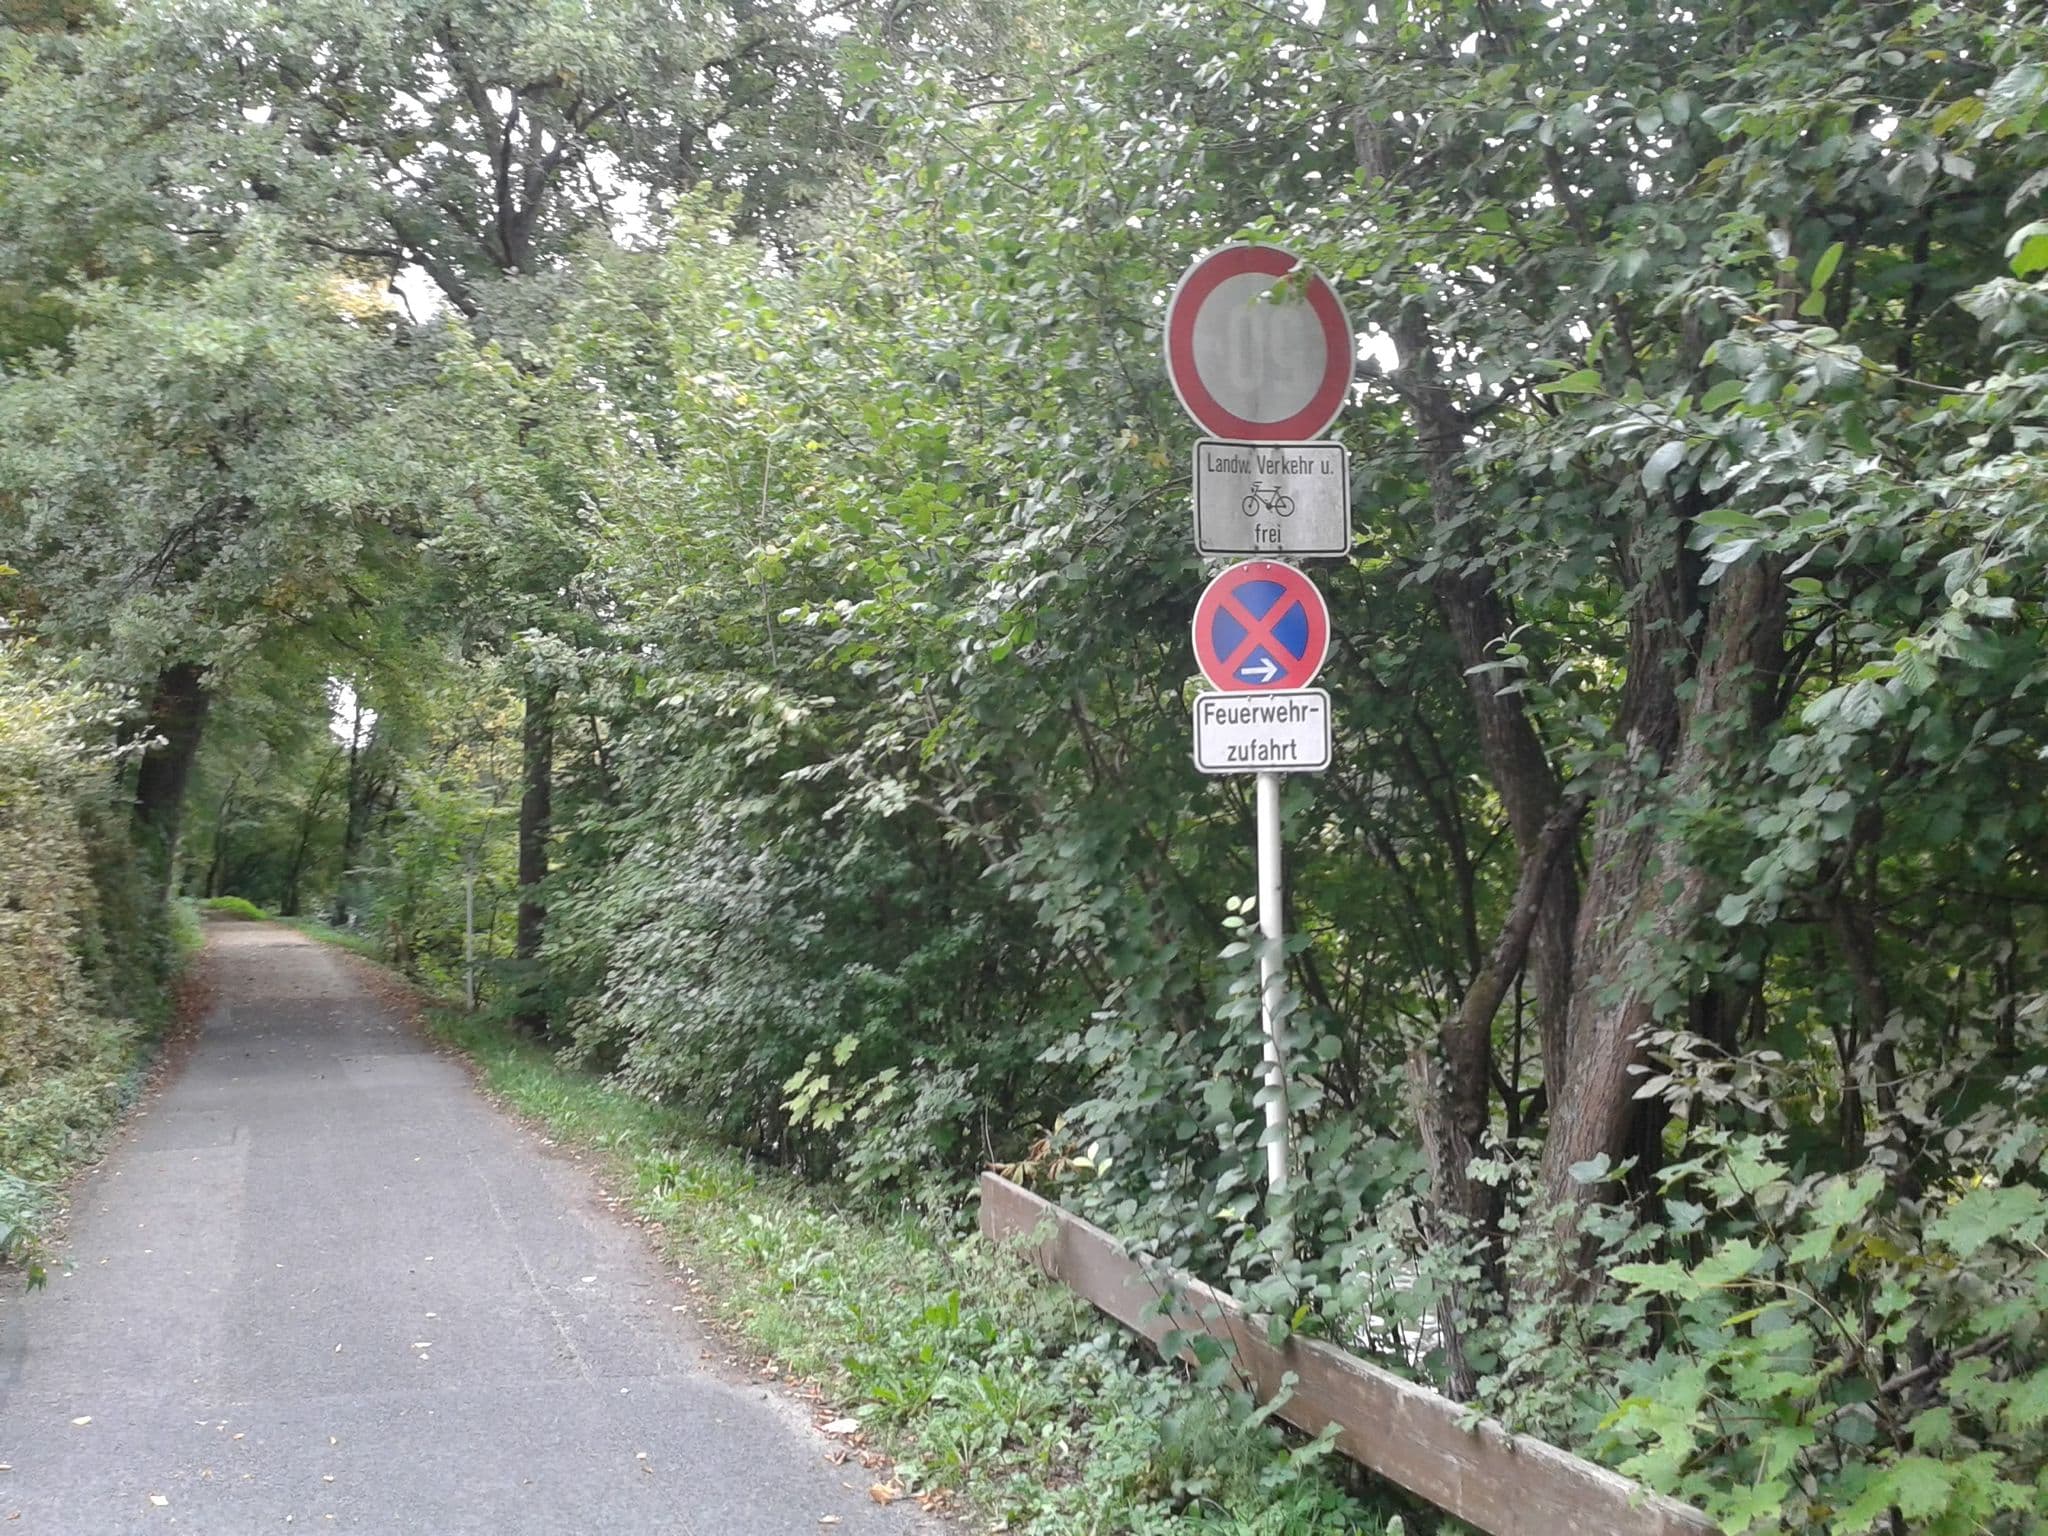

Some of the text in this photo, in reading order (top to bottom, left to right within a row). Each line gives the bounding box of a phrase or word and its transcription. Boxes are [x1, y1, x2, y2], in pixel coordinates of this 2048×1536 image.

[1207, 452, 1334, 475] Landw. Verkehr u.
[1255, 523, 1281, 543] frei
[1204, 700, 1319, 725] Feuerwehr-
[1227, 738, 1298, 762] zufahrt
